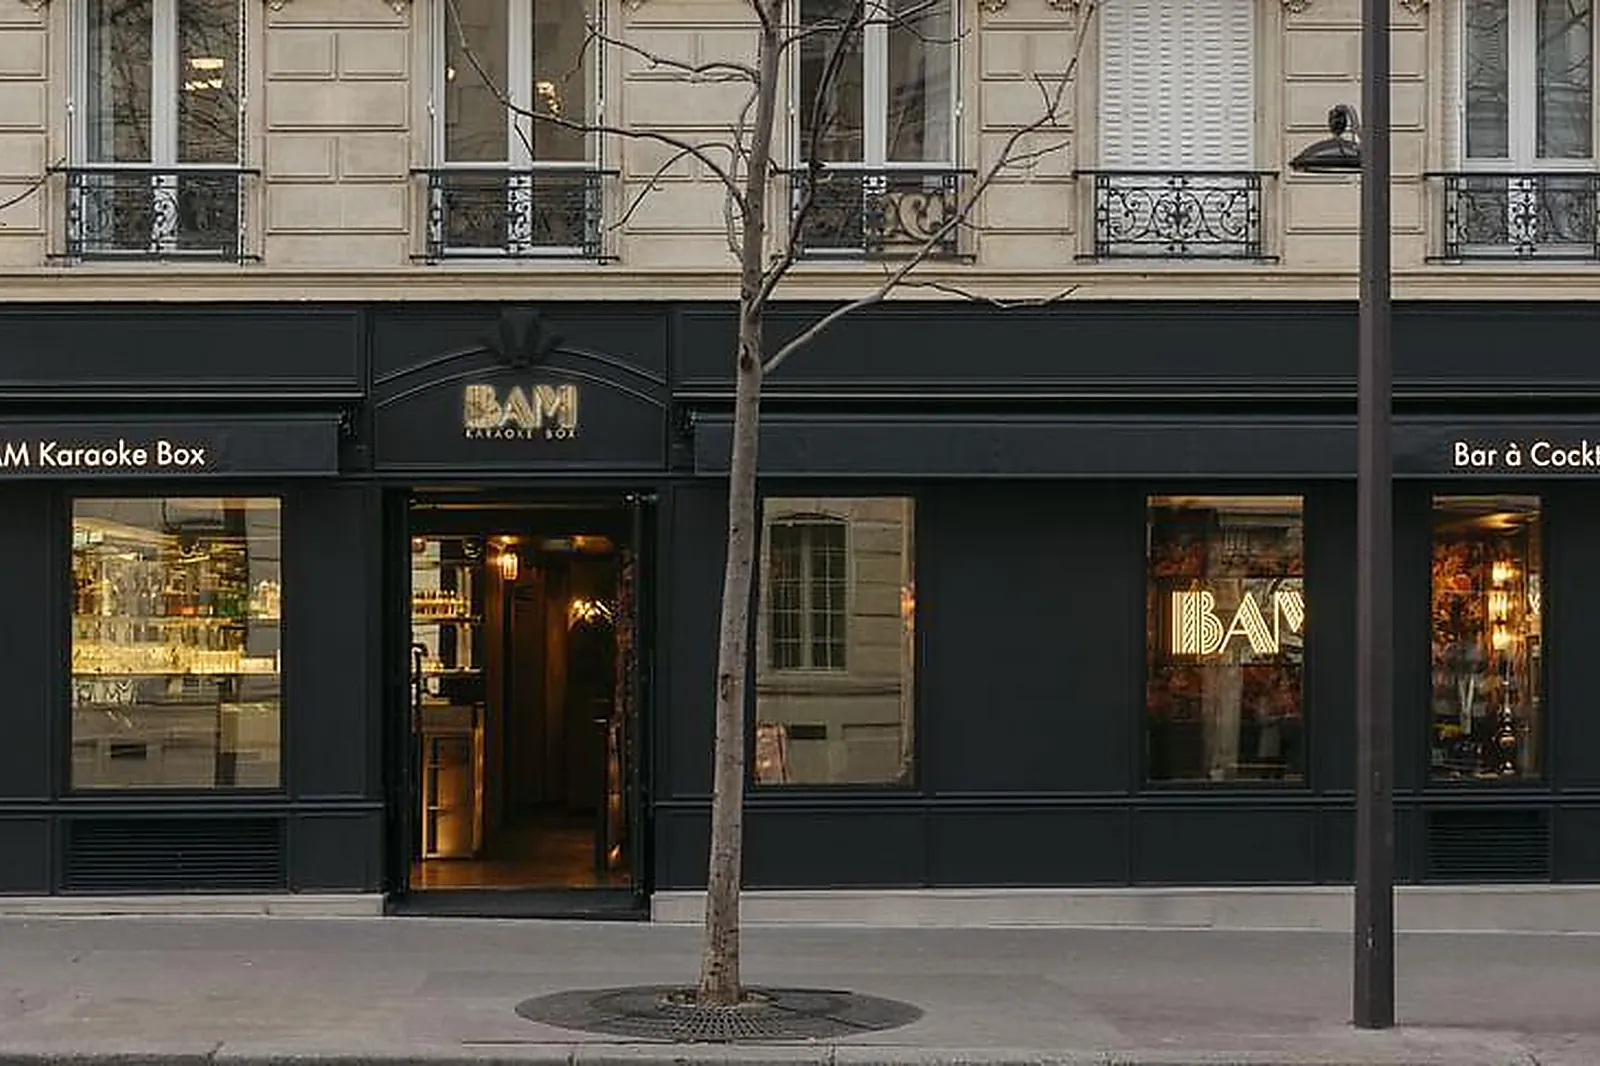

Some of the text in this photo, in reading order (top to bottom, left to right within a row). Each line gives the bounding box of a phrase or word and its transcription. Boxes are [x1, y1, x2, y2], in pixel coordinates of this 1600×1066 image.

[464, 385, 578, 428] BAM
[0, 439, 205, 466] M Karaoke Box
[1454, 442, 1498, 466] Bar
[1505, 443, 1522, 466] à
